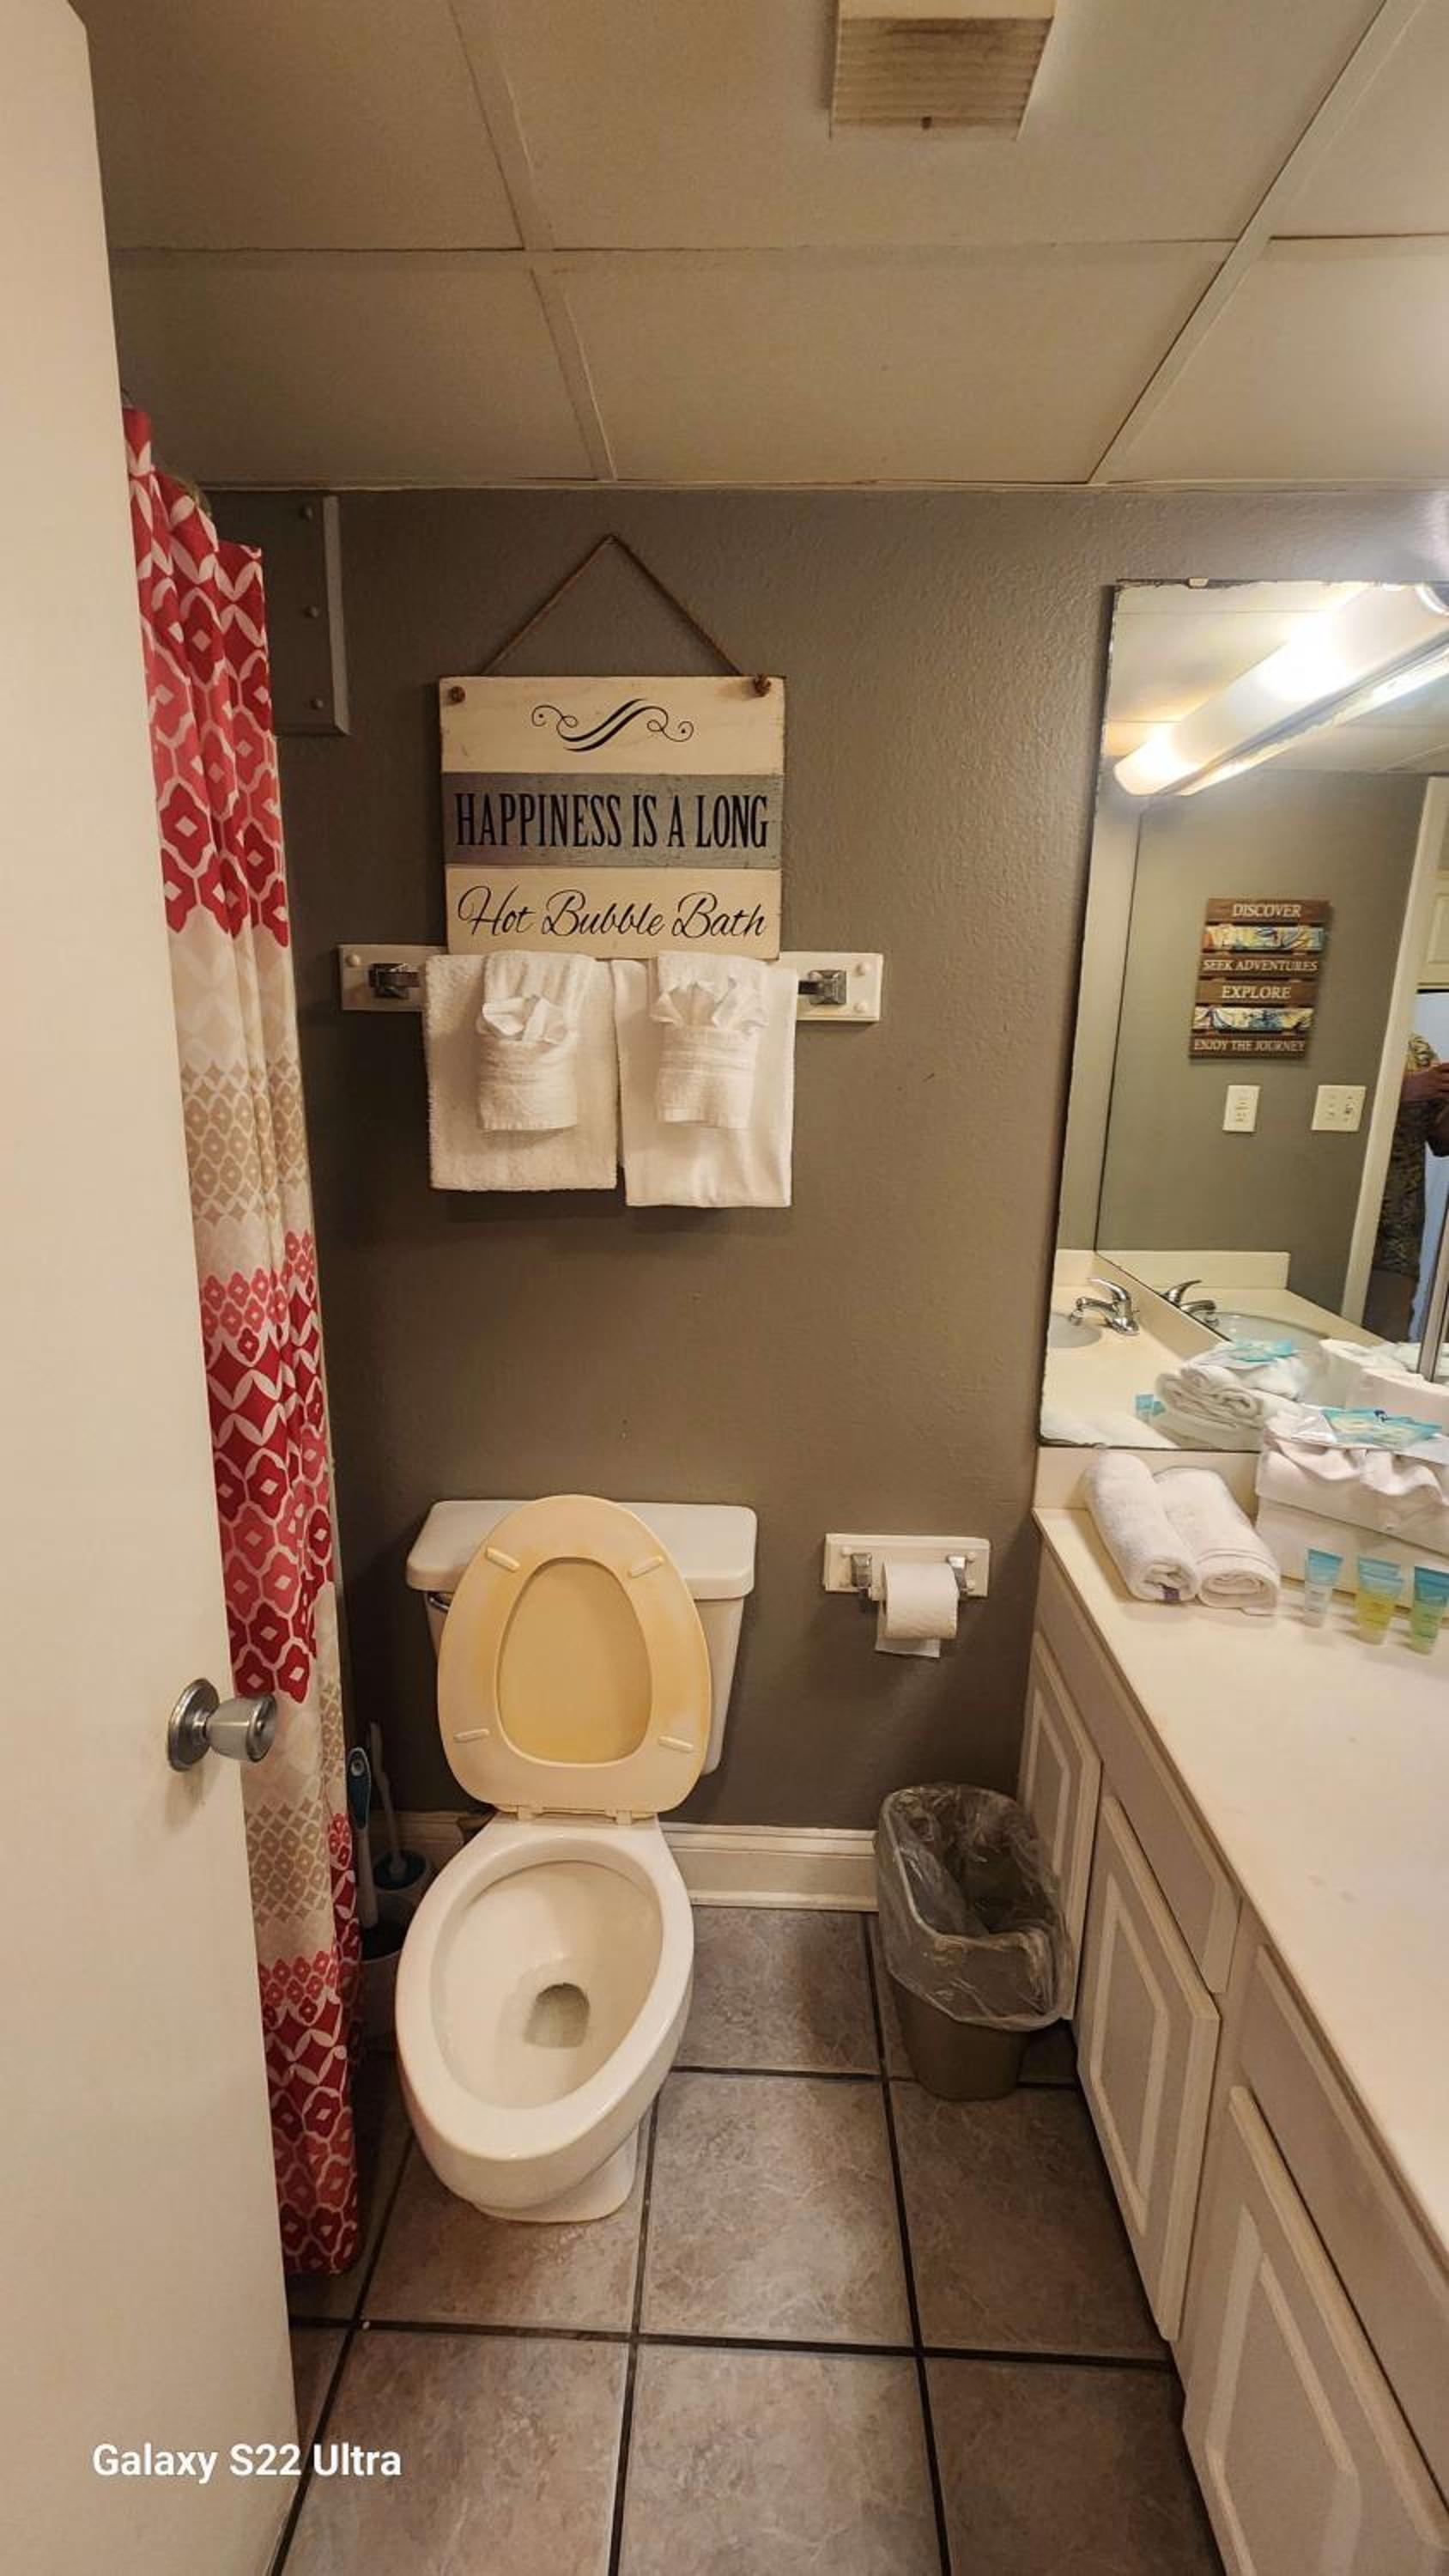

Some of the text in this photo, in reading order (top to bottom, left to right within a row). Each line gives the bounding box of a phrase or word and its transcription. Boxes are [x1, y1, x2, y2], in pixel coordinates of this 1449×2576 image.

[455, 793, 768, 848] HAPPINESS IS A LONG
[457, 884, 767, 939] Hot Bubble Bath
[1232, 904, 1301, 918] DISCOVER
[1203, 959, 1319, 972] SEEK ADVENTURES
[1222, 986, 1291, 999] EXPLORE
[1194, 1039, 1305, 1053] ENJOY THE JOURNEY
